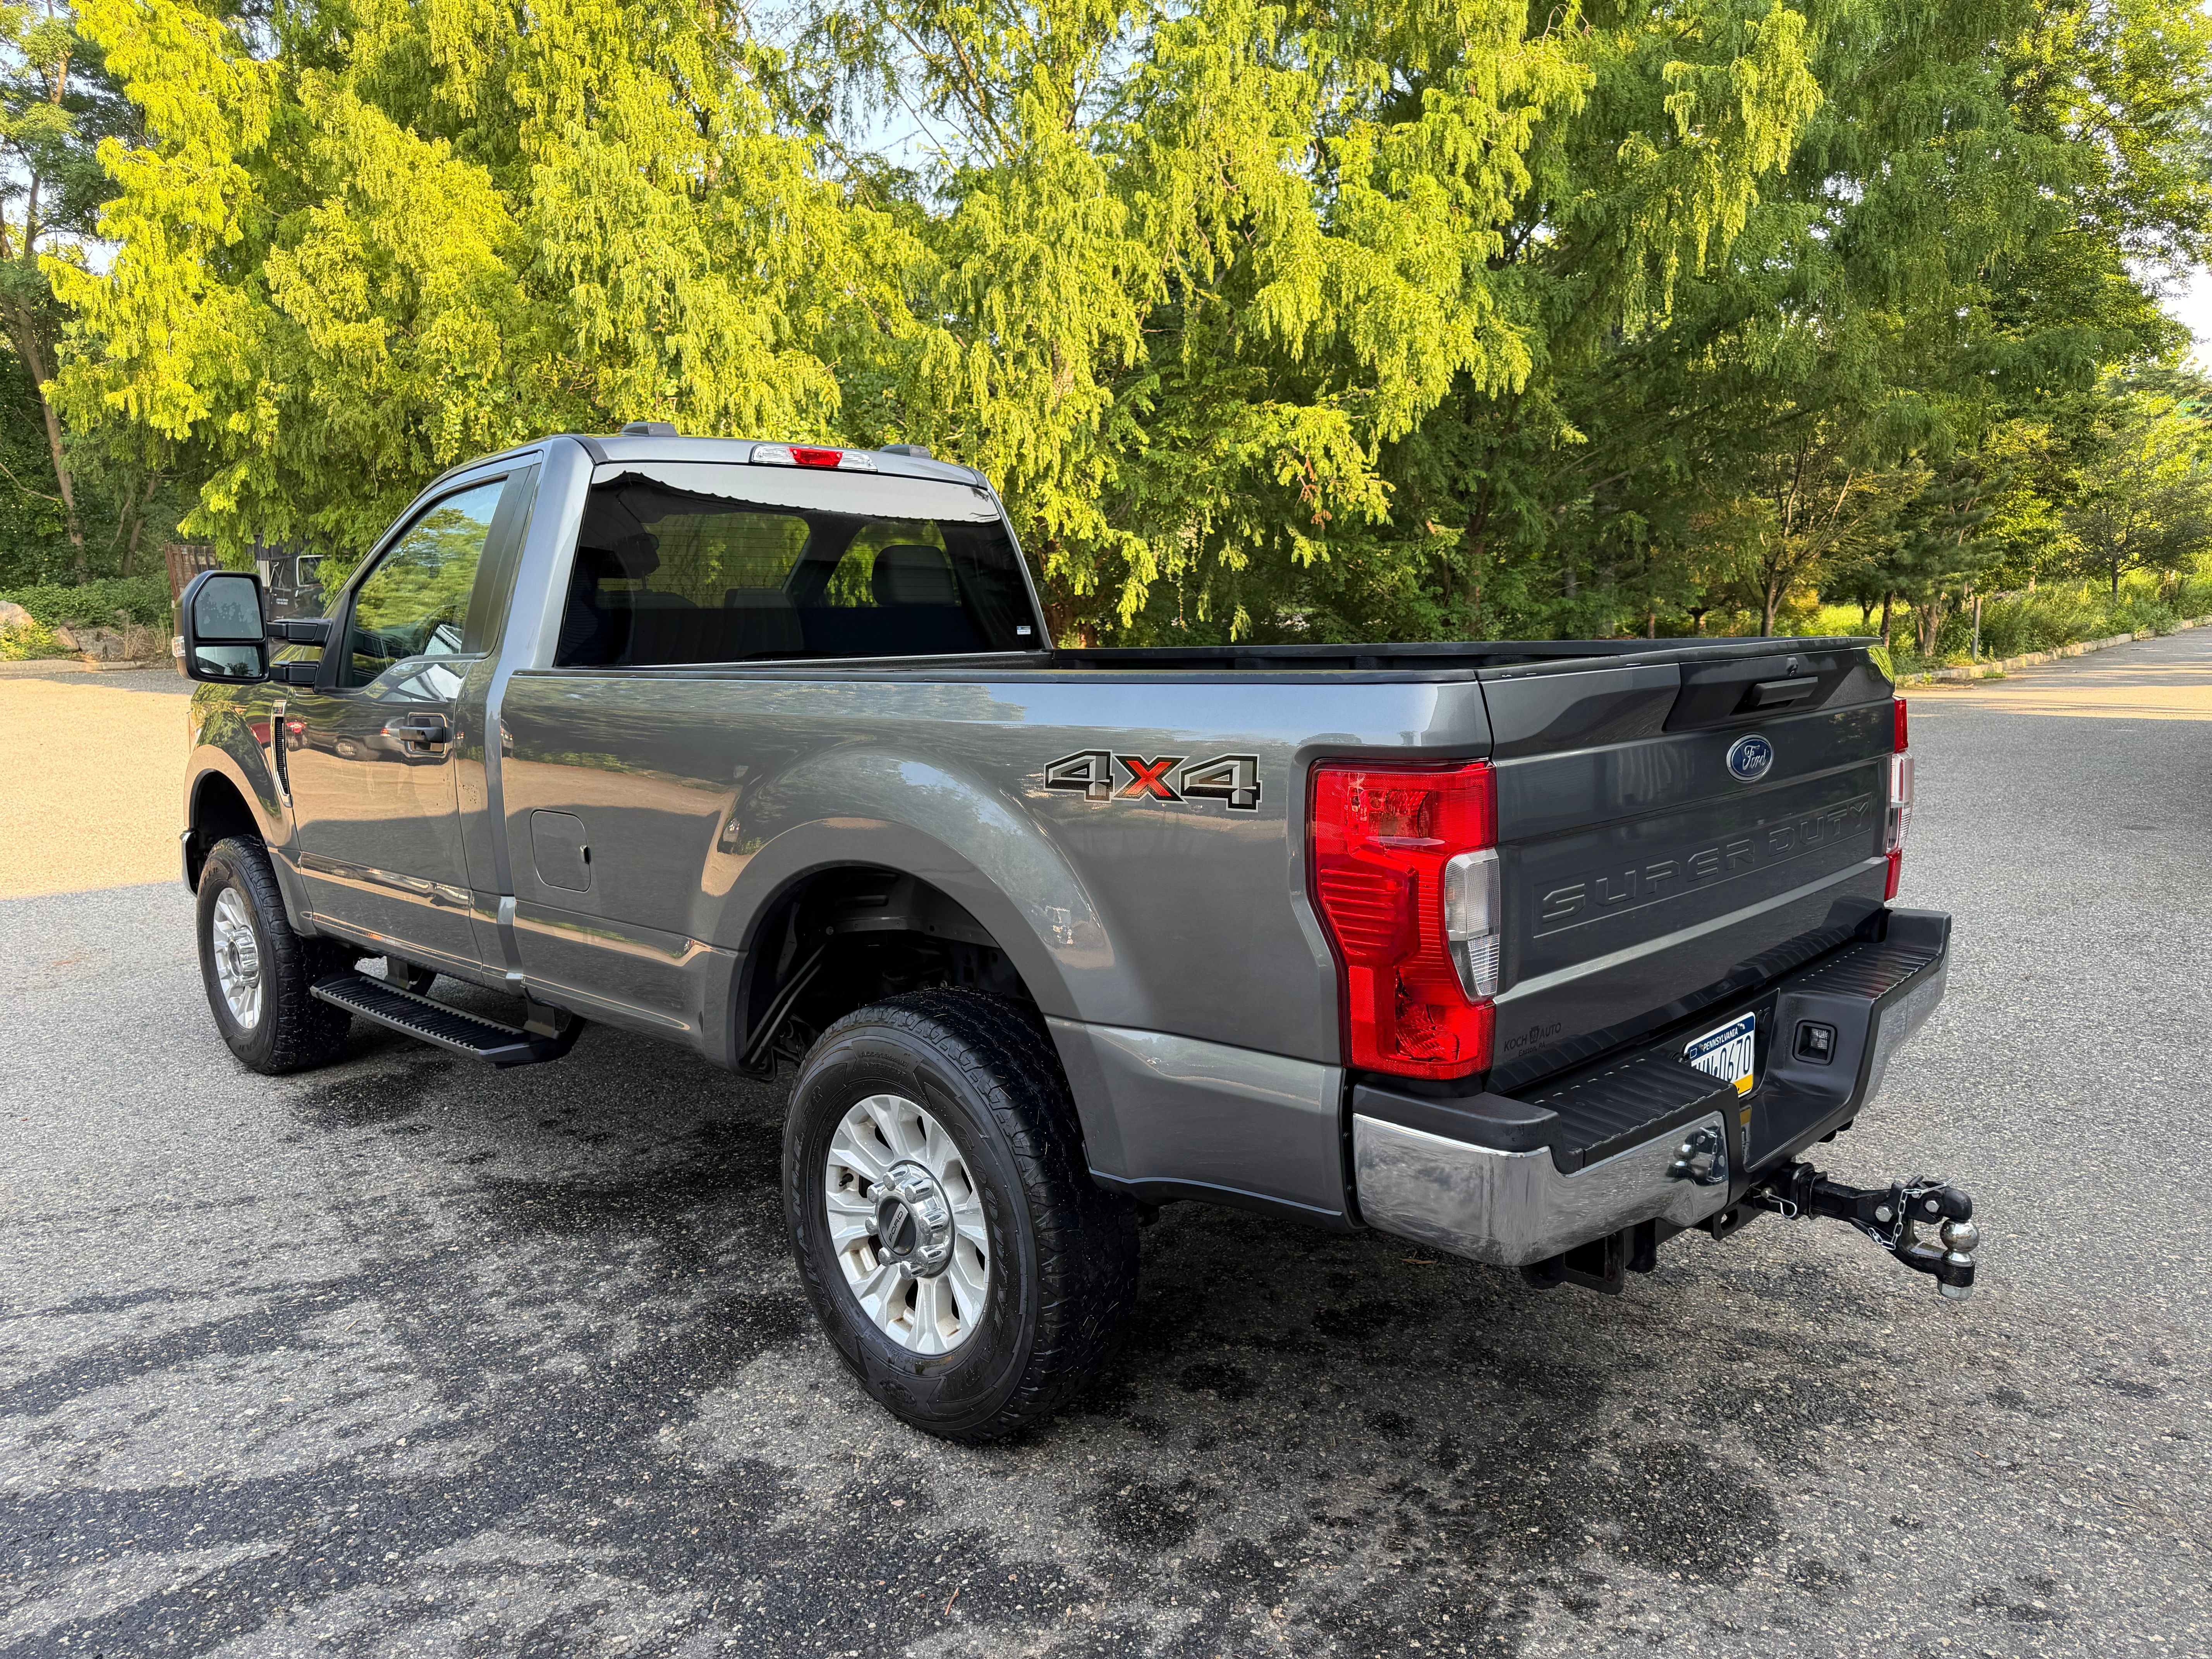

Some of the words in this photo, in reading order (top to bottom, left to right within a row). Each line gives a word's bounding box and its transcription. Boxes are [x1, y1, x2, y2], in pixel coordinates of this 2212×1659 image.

[1743, 744, 1767, 771] Ford
[1542, 838, 1755, 923] SUPER
[1768, 799, 1870, 857] DUTY
[1504, 1034, 1528, 1052] KOCH
[1539, 1022, 1562, 1040] AUTO
[1518, 1046, 1537, 1057] Easton,
[1539, 1041, 1546, 1050] PA
[1703, 1027, 1738, 1052] PENNSYLVANIA
[888, 1211, 903, 1243] FORD
